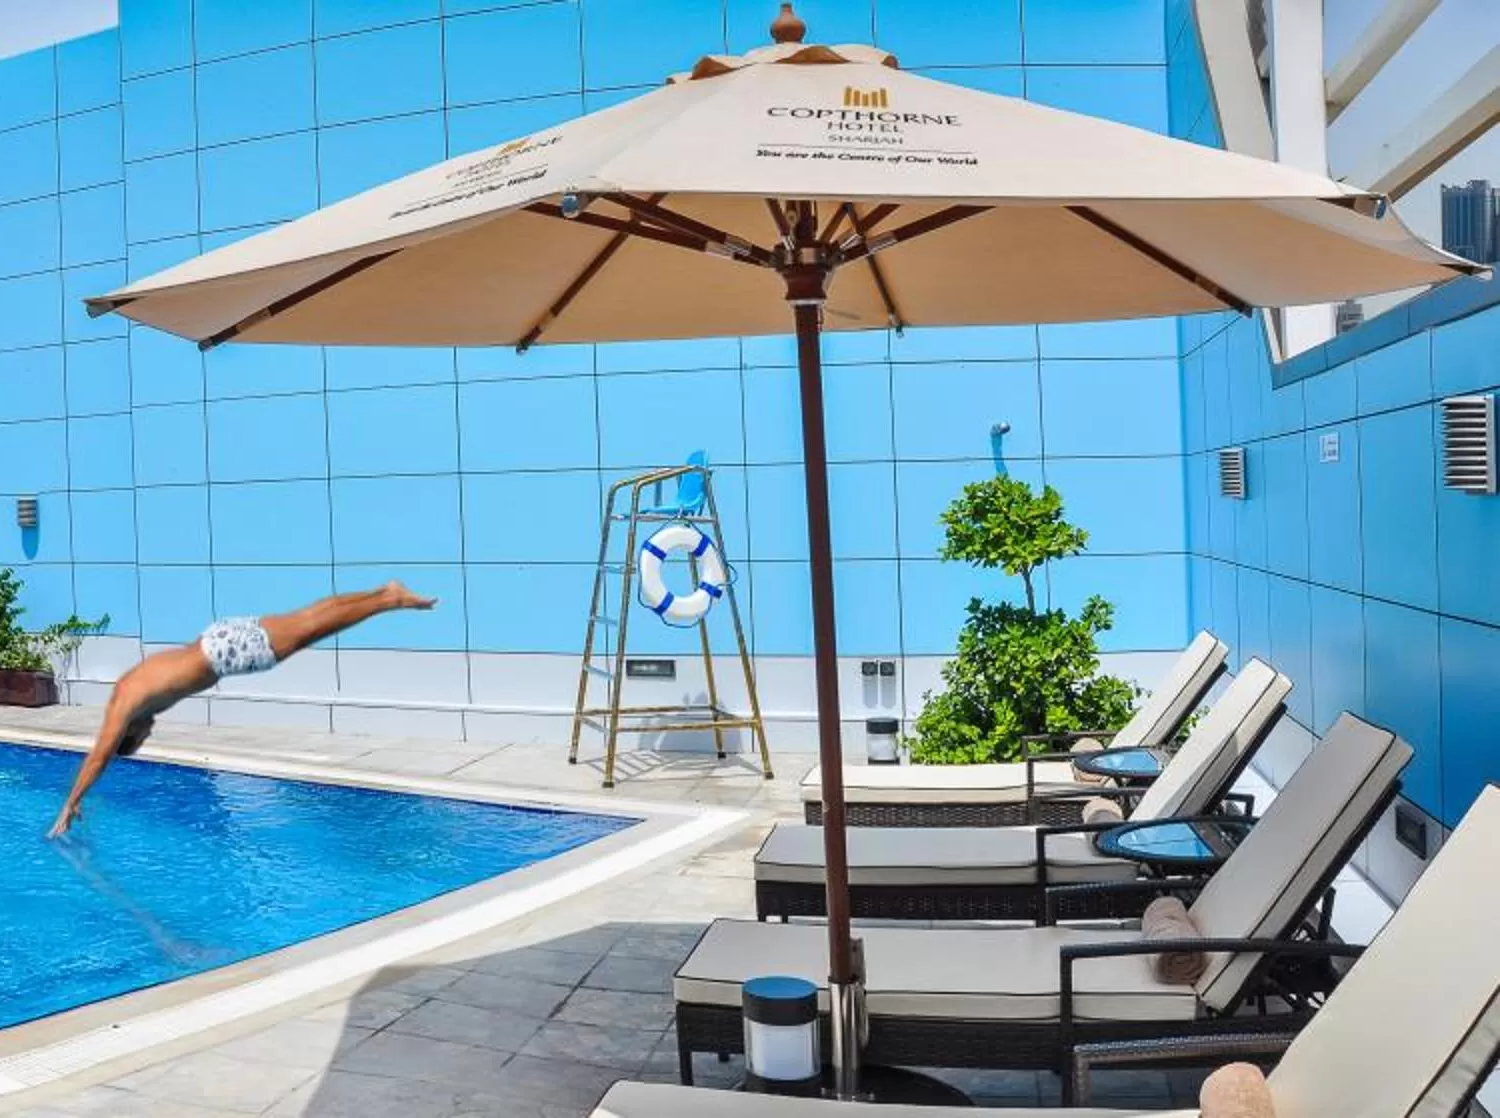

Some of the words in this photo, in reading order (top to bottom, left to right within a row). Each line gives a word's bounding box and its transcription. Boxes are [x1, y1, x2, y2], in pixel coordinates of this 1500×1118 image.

[766, 106, 962, 127] COPTHORNE
[827, 121, 904, 133] HOTEL
[756, 149, 782, 158] You
[812, 151, 834, 160] the
[838, 153, 885, 162] Centre
[887, 155, 903, 164] of
[905, 155, 933, 163] Our
[937, 156, 978, 166] World
